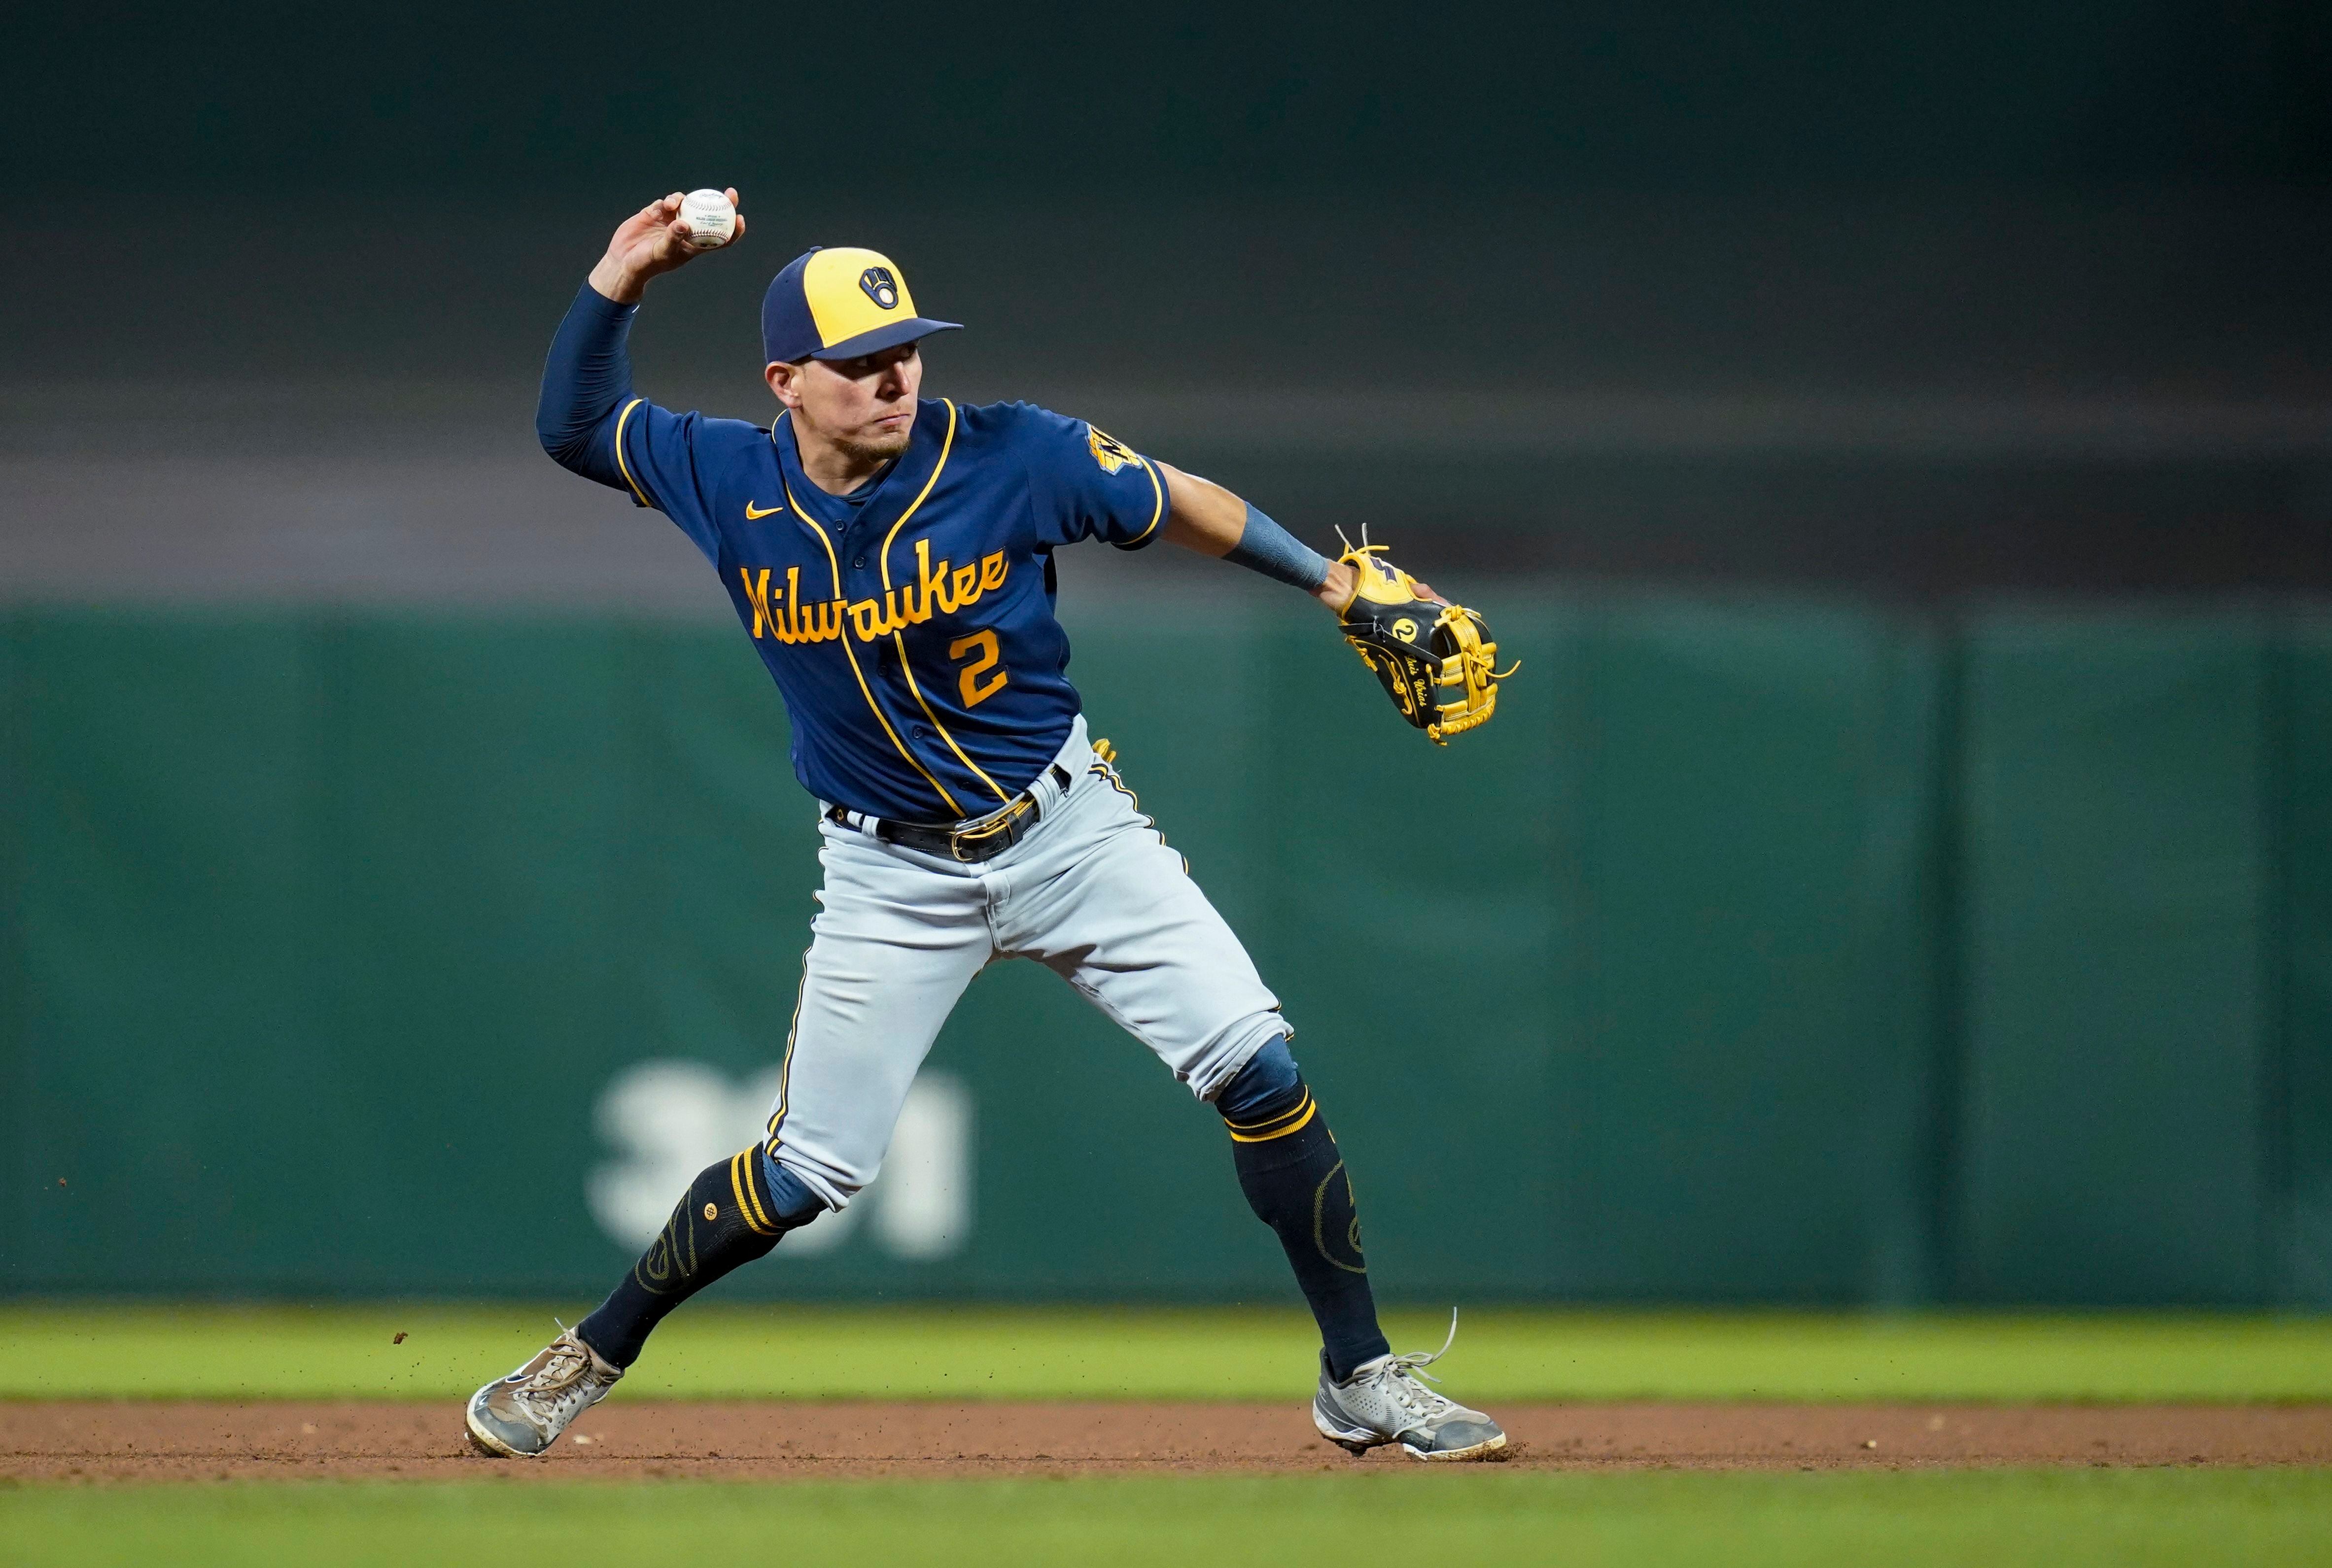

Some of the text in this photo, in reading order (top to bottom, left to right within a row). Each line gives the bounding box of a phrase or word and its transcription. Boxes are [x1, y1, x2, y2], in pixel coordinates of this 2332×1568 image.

[741, 538, 1009, 644] Milwaukee
[1395, 625, 1414, 639] 2
[949, 629, 1008, 708] 2
[1414, 679, 1427, 707] Urias
